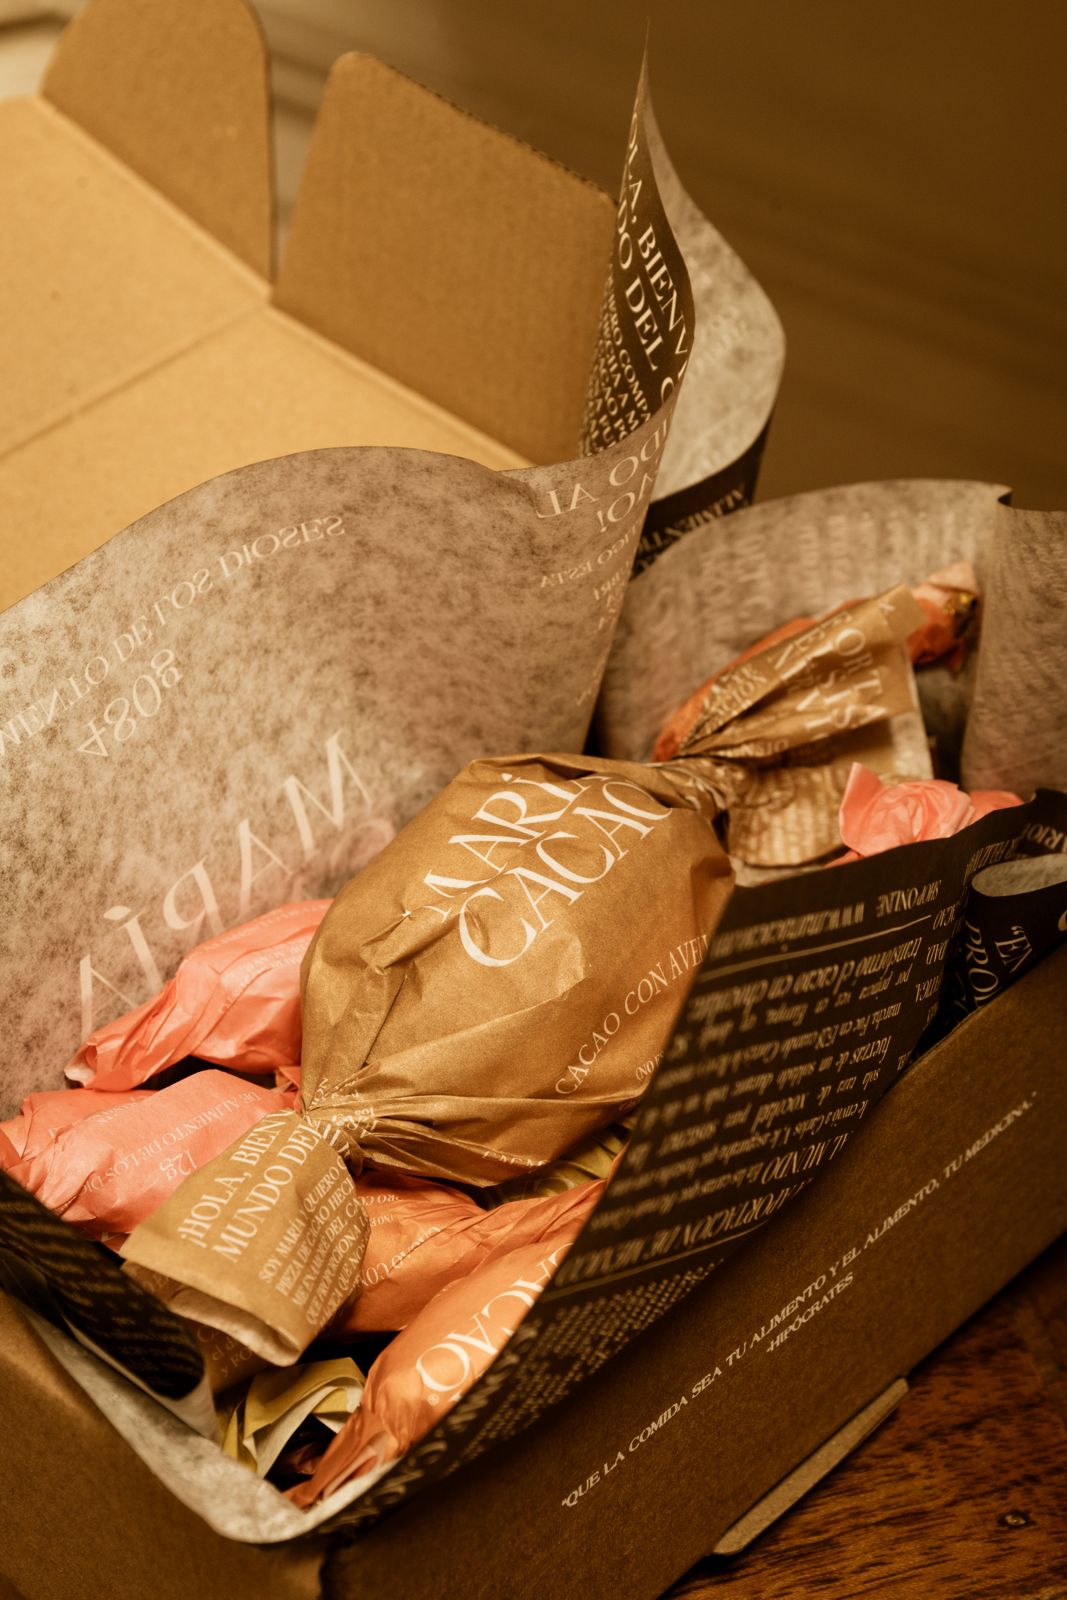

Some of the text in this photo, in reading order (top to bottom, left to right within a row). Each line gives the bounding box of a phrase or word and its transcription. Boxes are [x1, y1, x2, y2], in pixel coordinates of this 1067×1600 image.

[625, 278, 664, 371] DEL
[458, 780, 673, 968] CACAO
[555, 1011, 621, 1094] CACAO
[624, 962, 669, 1016] CON
[139, 1139, 161, 1160] DE
[161, 1097, 247, 1147] ALIMENTO
[160, 1150, 197, 1181] 12g
[177, 1170, 252, 1249] ¡HOLA,
[212, 1163, 294, 1264] MUNDO
[258, 1251, 280, 1284] SOY
[276, 1217, 306, 1257] MARÍA
[304, 1174, 341, 1215] QUIERO
[325, 1215, 349, 1243] DEL
[275, 1262, 301, 1298] PIEZA
[603, 1451, 625, 1476] LA
[628, 1396, 689, 1453] COMIDA
[692, 1366, 722, 1399] SEA
[725, 1342, 747, 1368] TU
[749, 1272, 826, 1349] ALIMENTO
[828, 1261, 841, 1278] Y
[841, 1247, 862, 1270] EL
[863, 1179, 940, 1249] ALIMENTO,
[943, 1155, 963, 1179] TU
